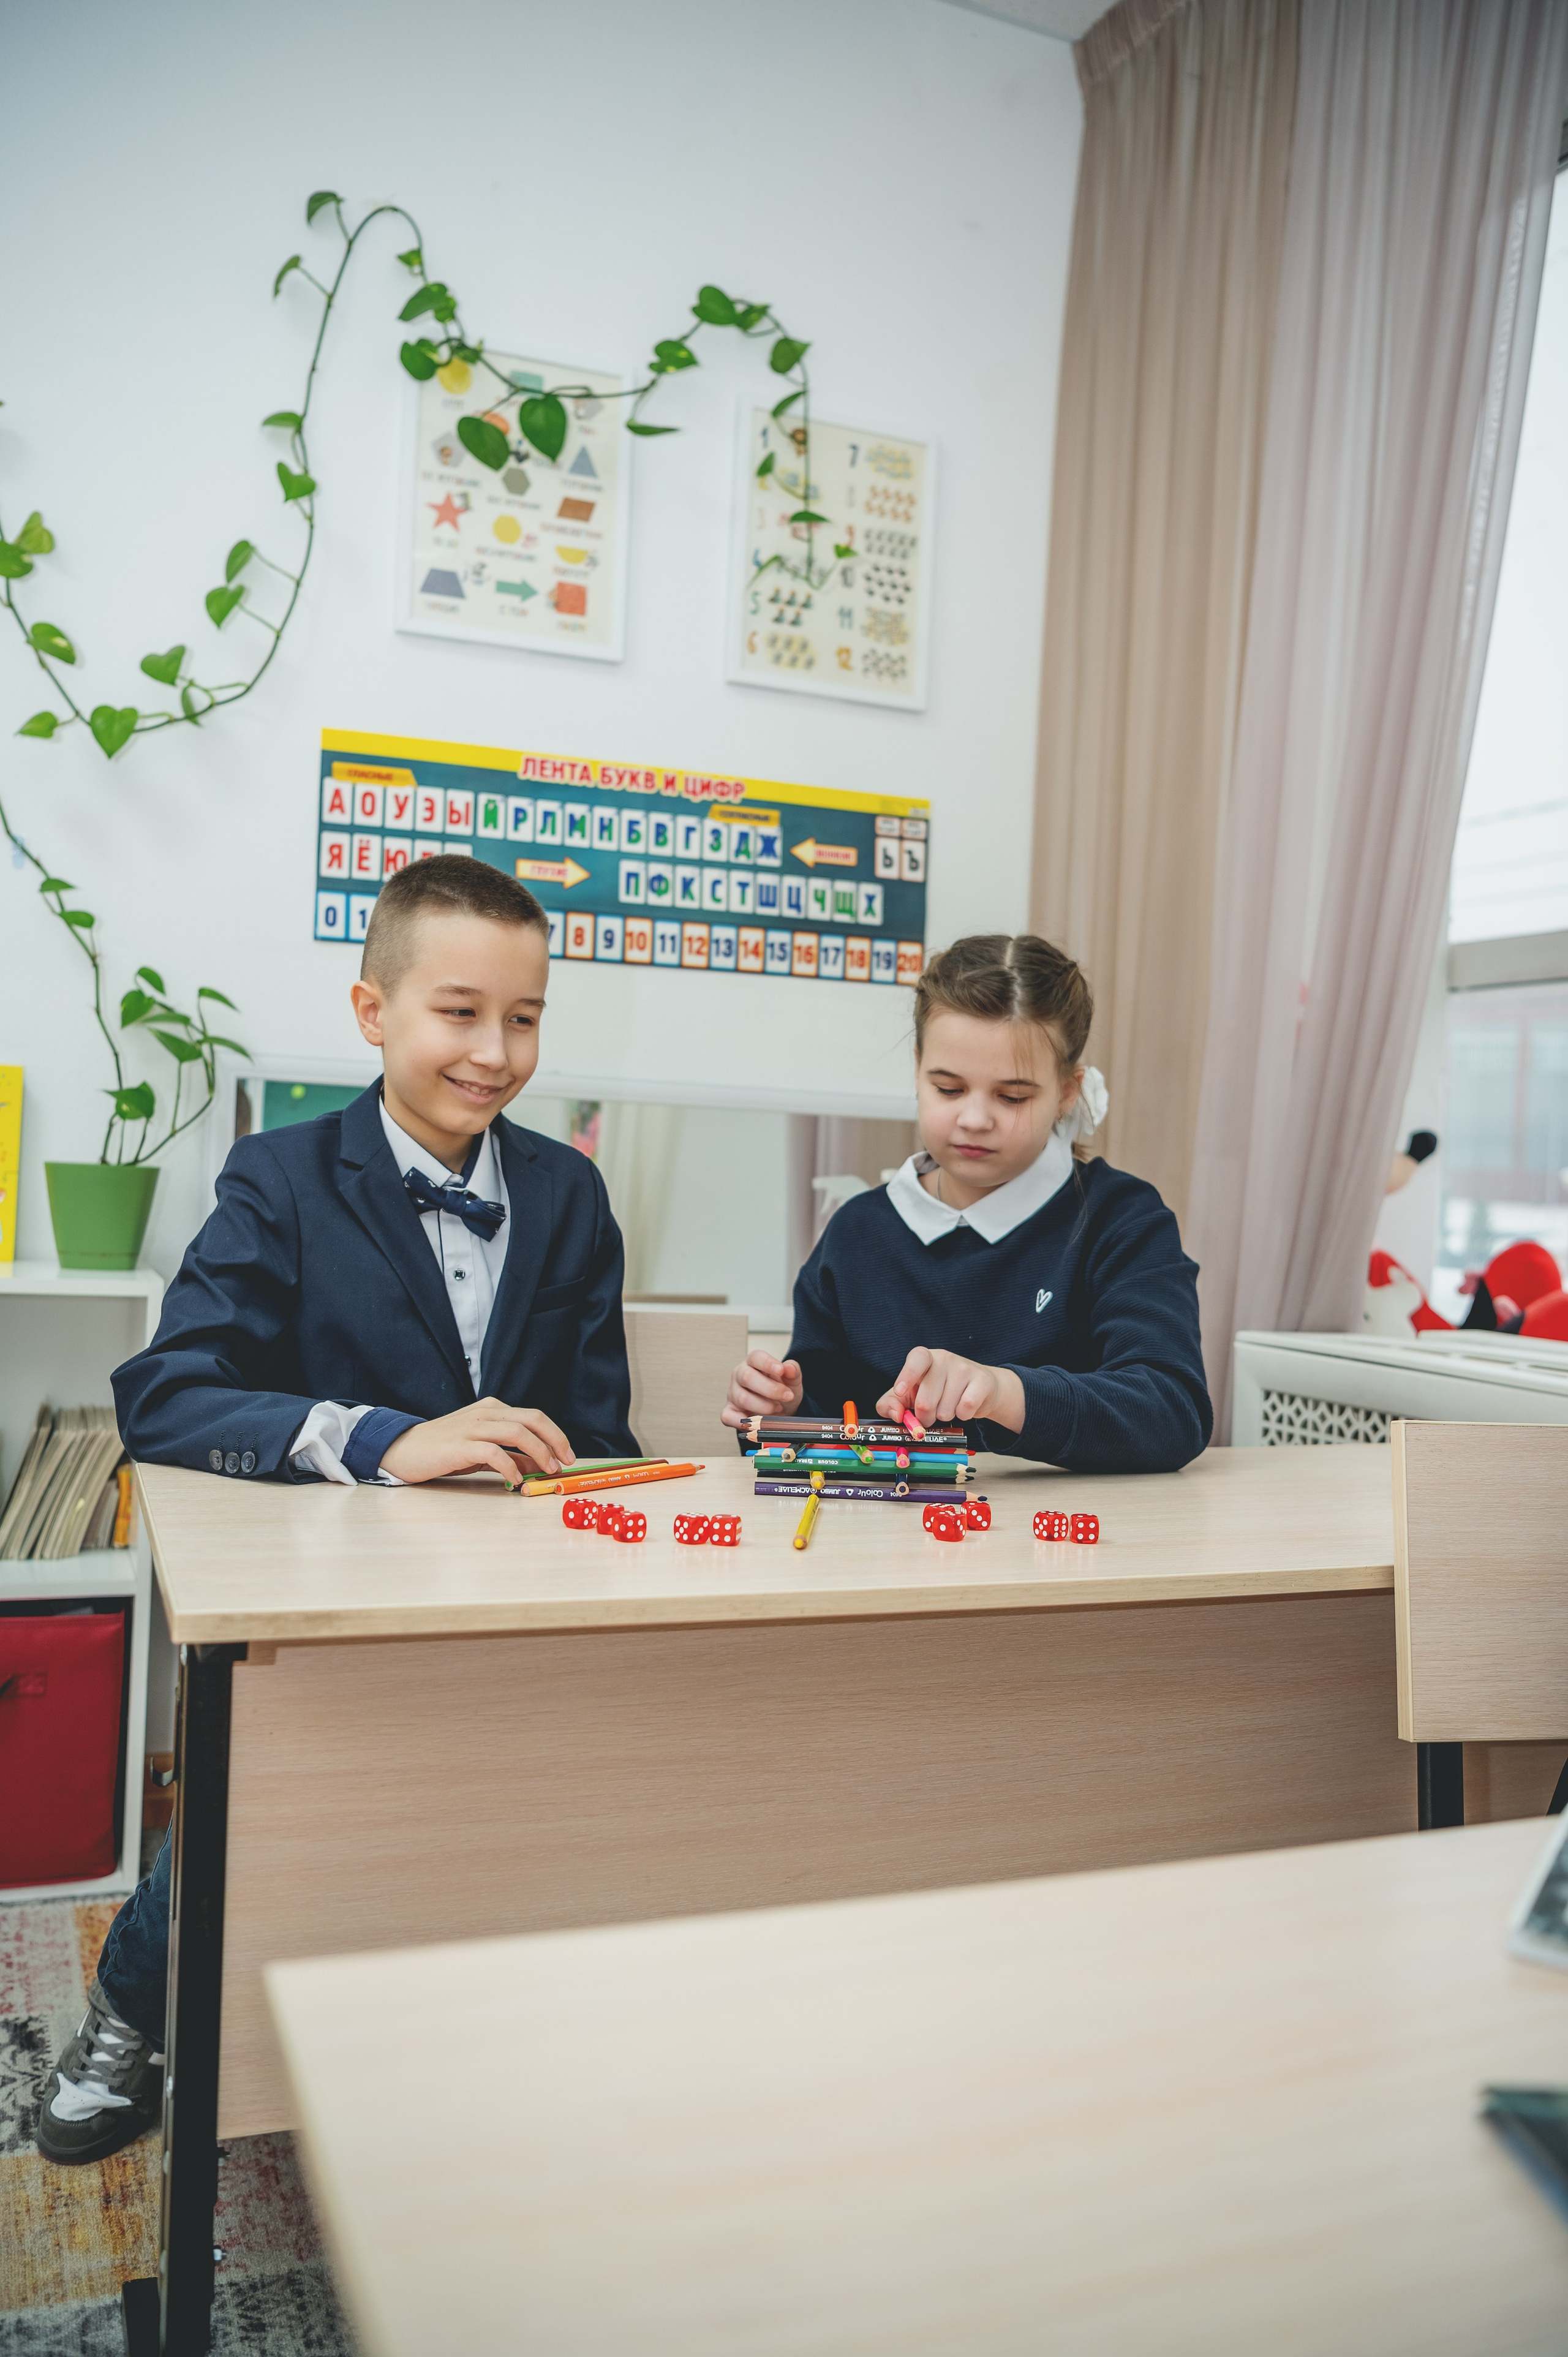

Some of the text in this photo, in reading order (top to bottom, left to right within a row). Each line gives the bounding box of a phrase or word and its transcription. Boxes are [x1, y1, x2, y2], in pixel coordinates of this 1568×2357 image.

[522, 758, 746, 798] ЛЕНТА БУКВ И ЦИФР
[330, 789, 778, 859] А О У Э Ы Й Р Л М Н Б В Г З Д Ж
[328, 839, 406, 873] Я Ё Ю
[626, 872, 876, 919] П Ф К С Т Ш Ц Ч Щ Х
[325, 906, 366, 929] 0 1
[574, 927, 584, 946] 8
[604, 929, 614, 949] 9
[627, 930, 647, 951] 10
[660, 934, 676, 953] 11
[687, 936, 707, 956] 12
[712, 938, 733, 957] 13
[741, 940, 761, 960] 14
[767, 943, 788, 961] 15
[794, 944, 815, 964] 16
[821, 946, 842, 965] 17
[848, 948, 867, 968] 18
[873, 951, 894, 970] 19
[897, 953, 922, 972] 20
[858, 1489, 883, 1498] Colour
